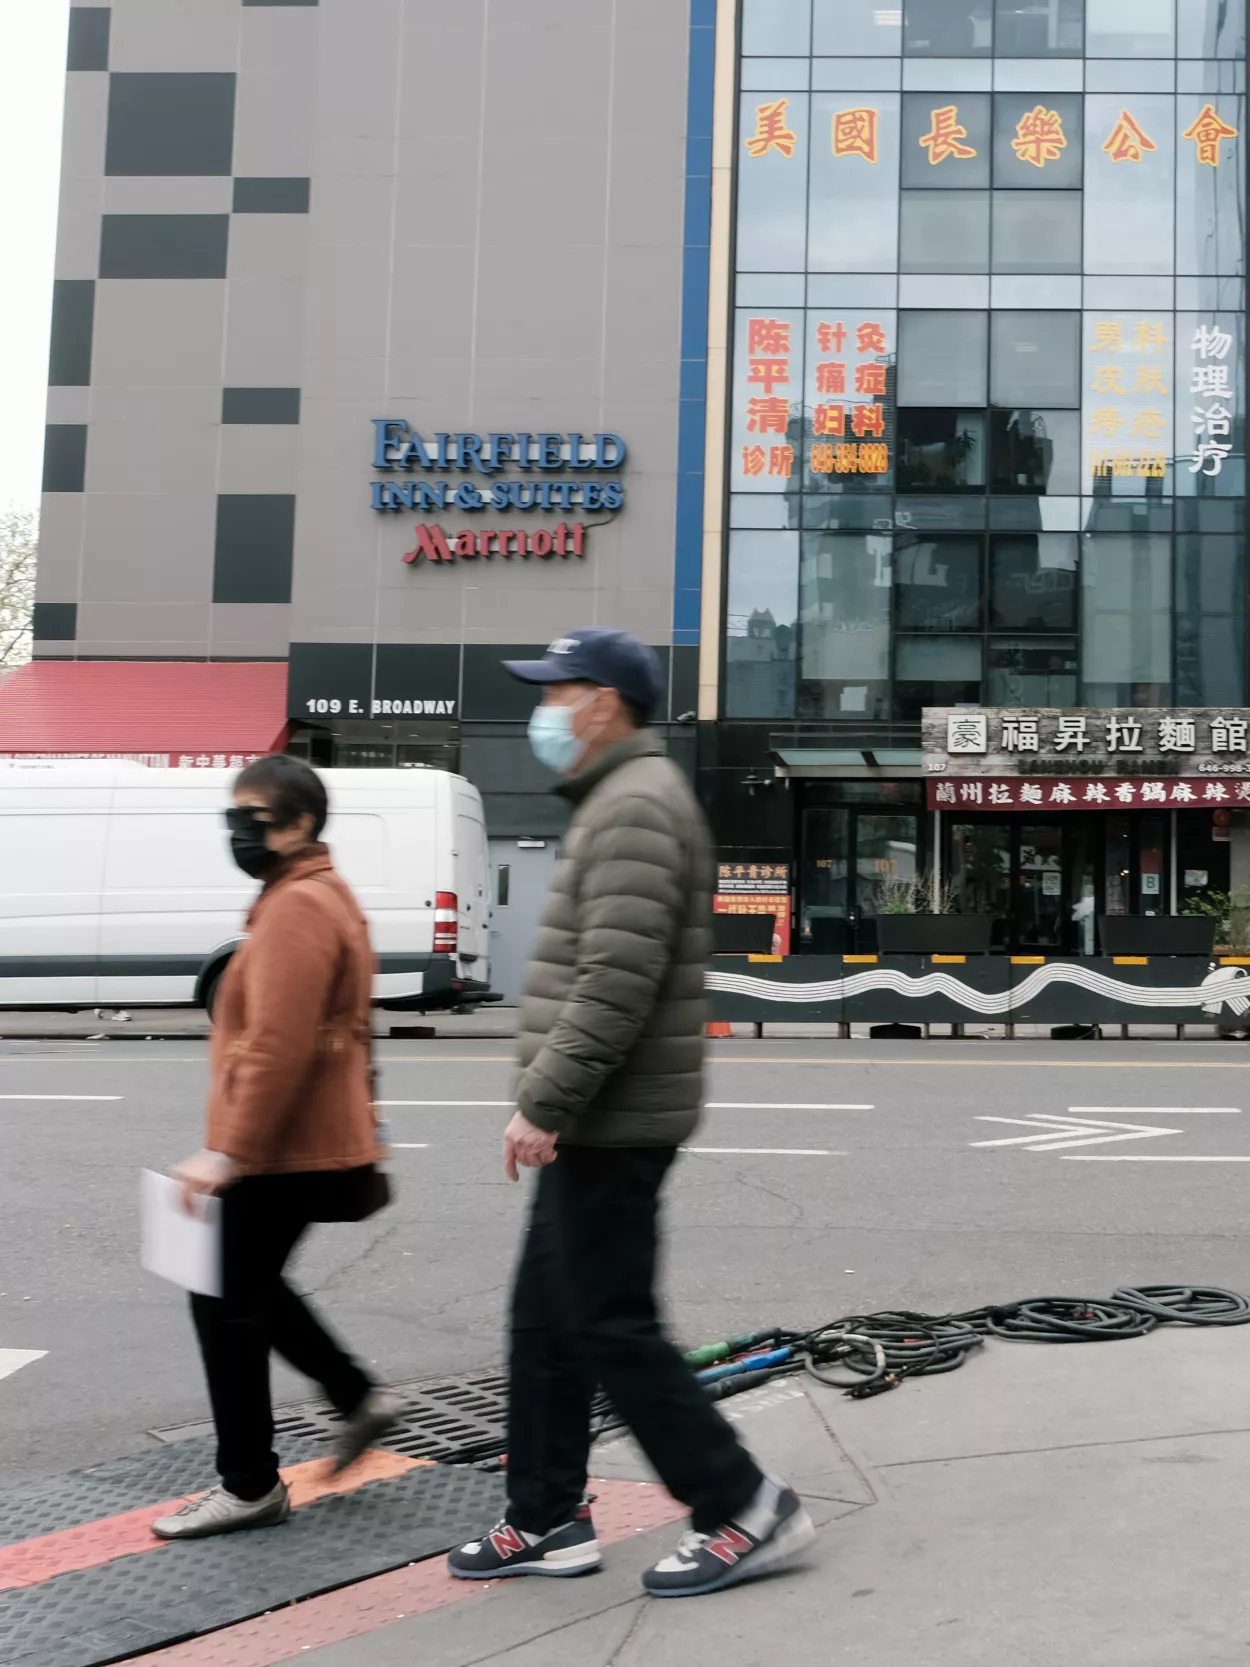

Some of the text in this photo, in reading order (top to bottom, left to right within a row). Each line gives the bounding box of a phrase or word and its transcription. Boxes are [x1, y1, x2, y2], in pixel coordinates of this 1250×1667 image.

[746, 98, 1239, 167] 美國長樂公會
[817, 320, 887, 354] 针灸
[1089, 321, 1168, 355] 男科
[815, 361, 887, 395] 痛症
[1090, 364, 1168, 395] 皮肤
[1188, 324, 1233, 477] 物理治疗
[812, 403, 885, 437] 妇科
[371, 419, 628, 474] FAIRFIELD
[742, 444, 795, 479] 诊所
[369, 481, 624, 510] INN & SUITES
[402, 522, 585, 563] Marriott
[306, 699, 456, 714] 109 E. BROADWAY
[928, 763, 947, 773] 107
